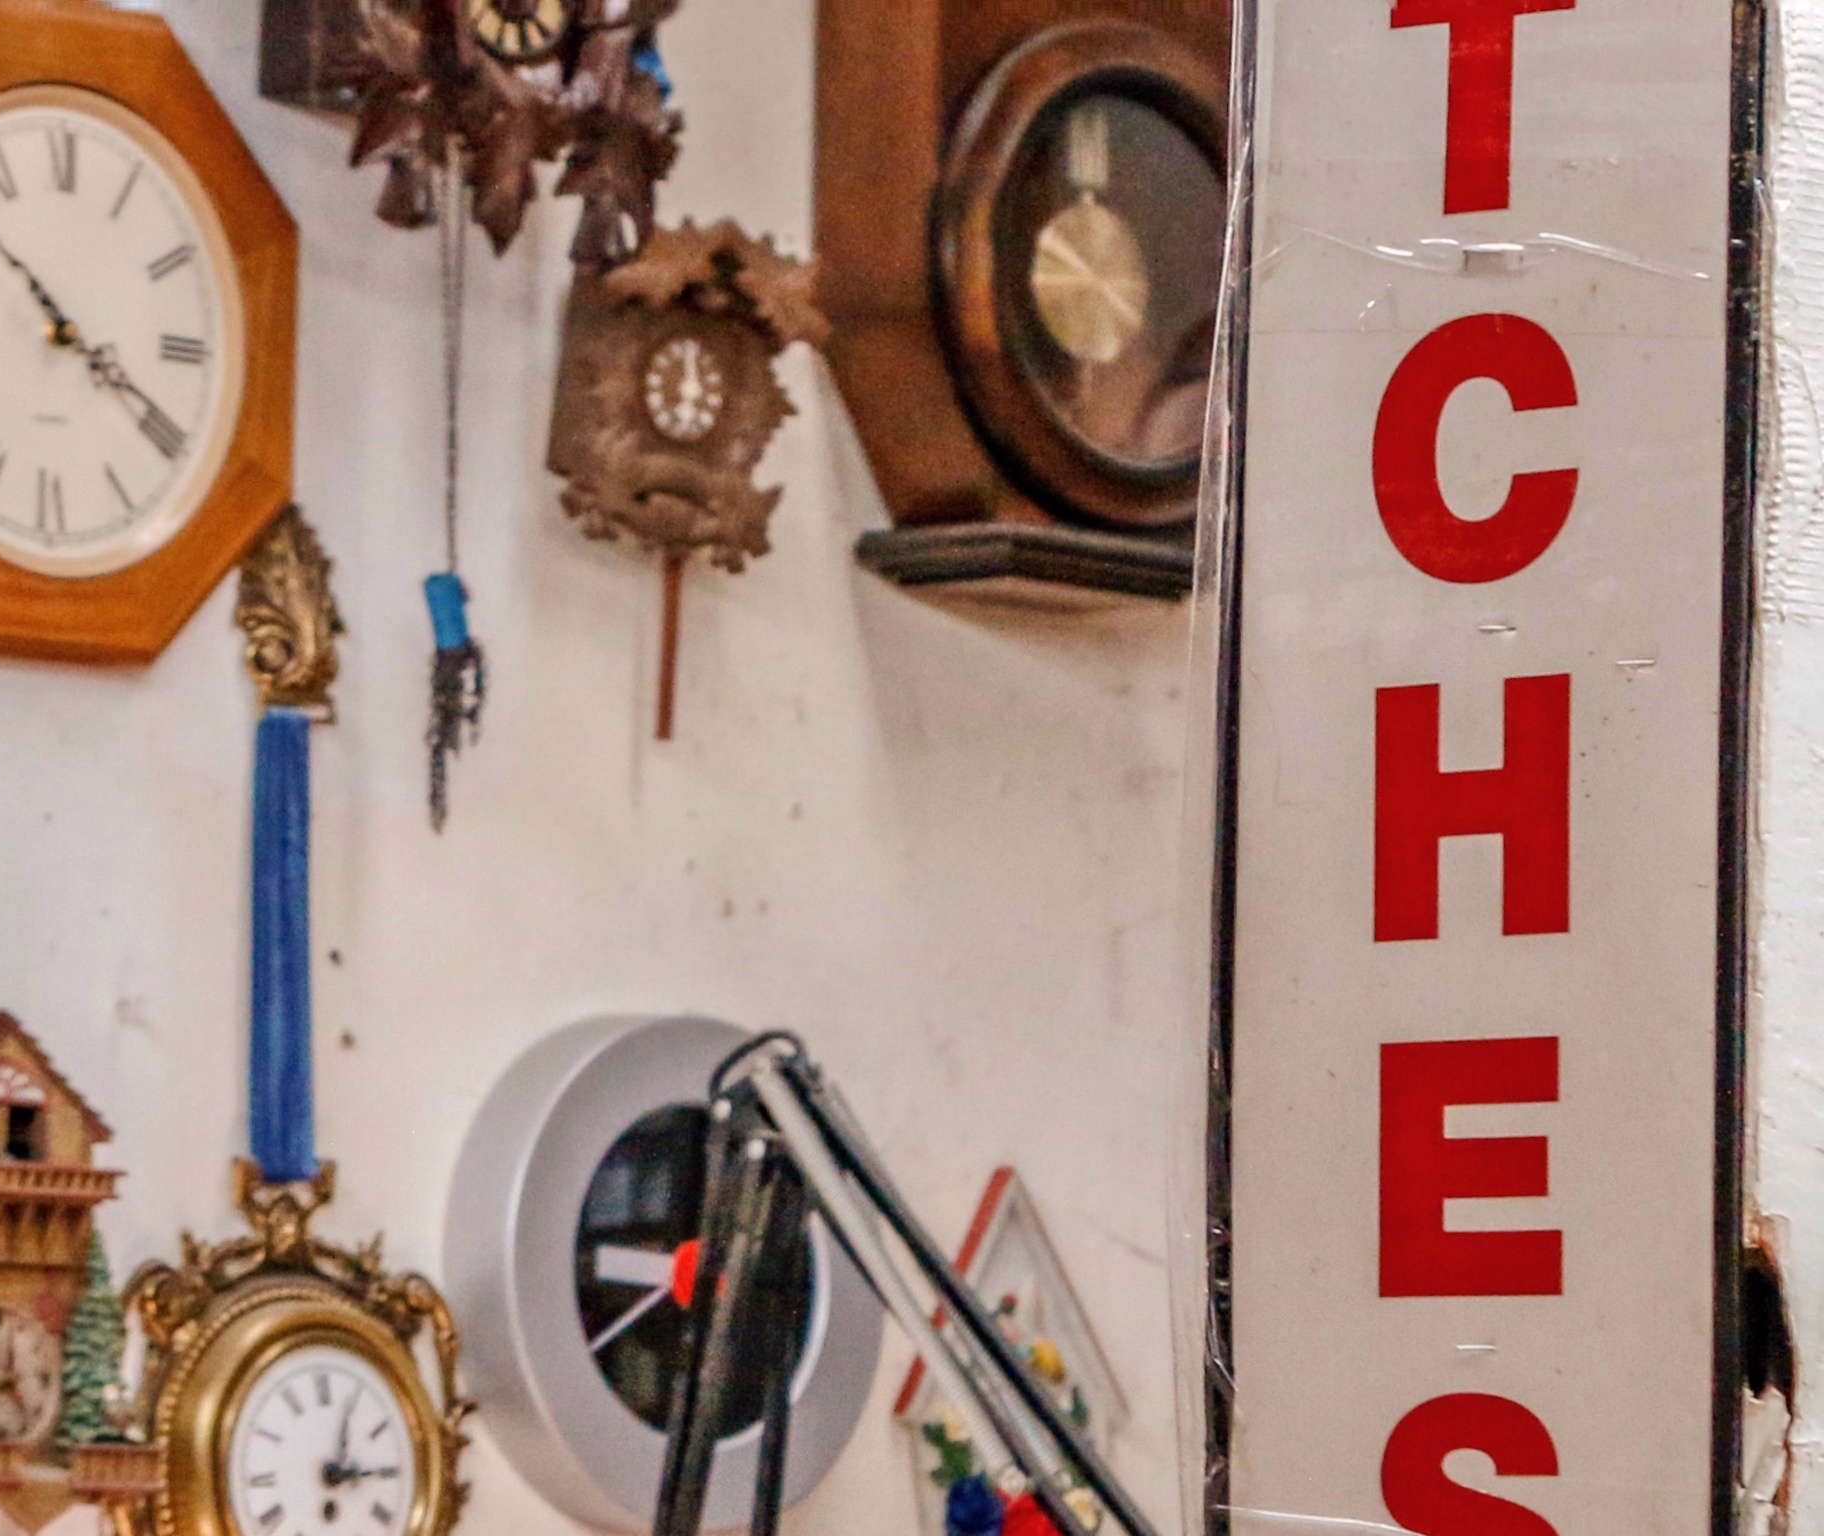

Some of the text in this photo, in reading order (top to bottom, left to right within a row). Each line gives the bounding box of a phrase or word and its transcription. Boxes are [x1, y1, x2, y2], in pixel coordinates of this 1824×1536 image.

[110, 161, 143, 219] I
[147, 245, 197, 280] II
[160, 334, 208, 364] III
